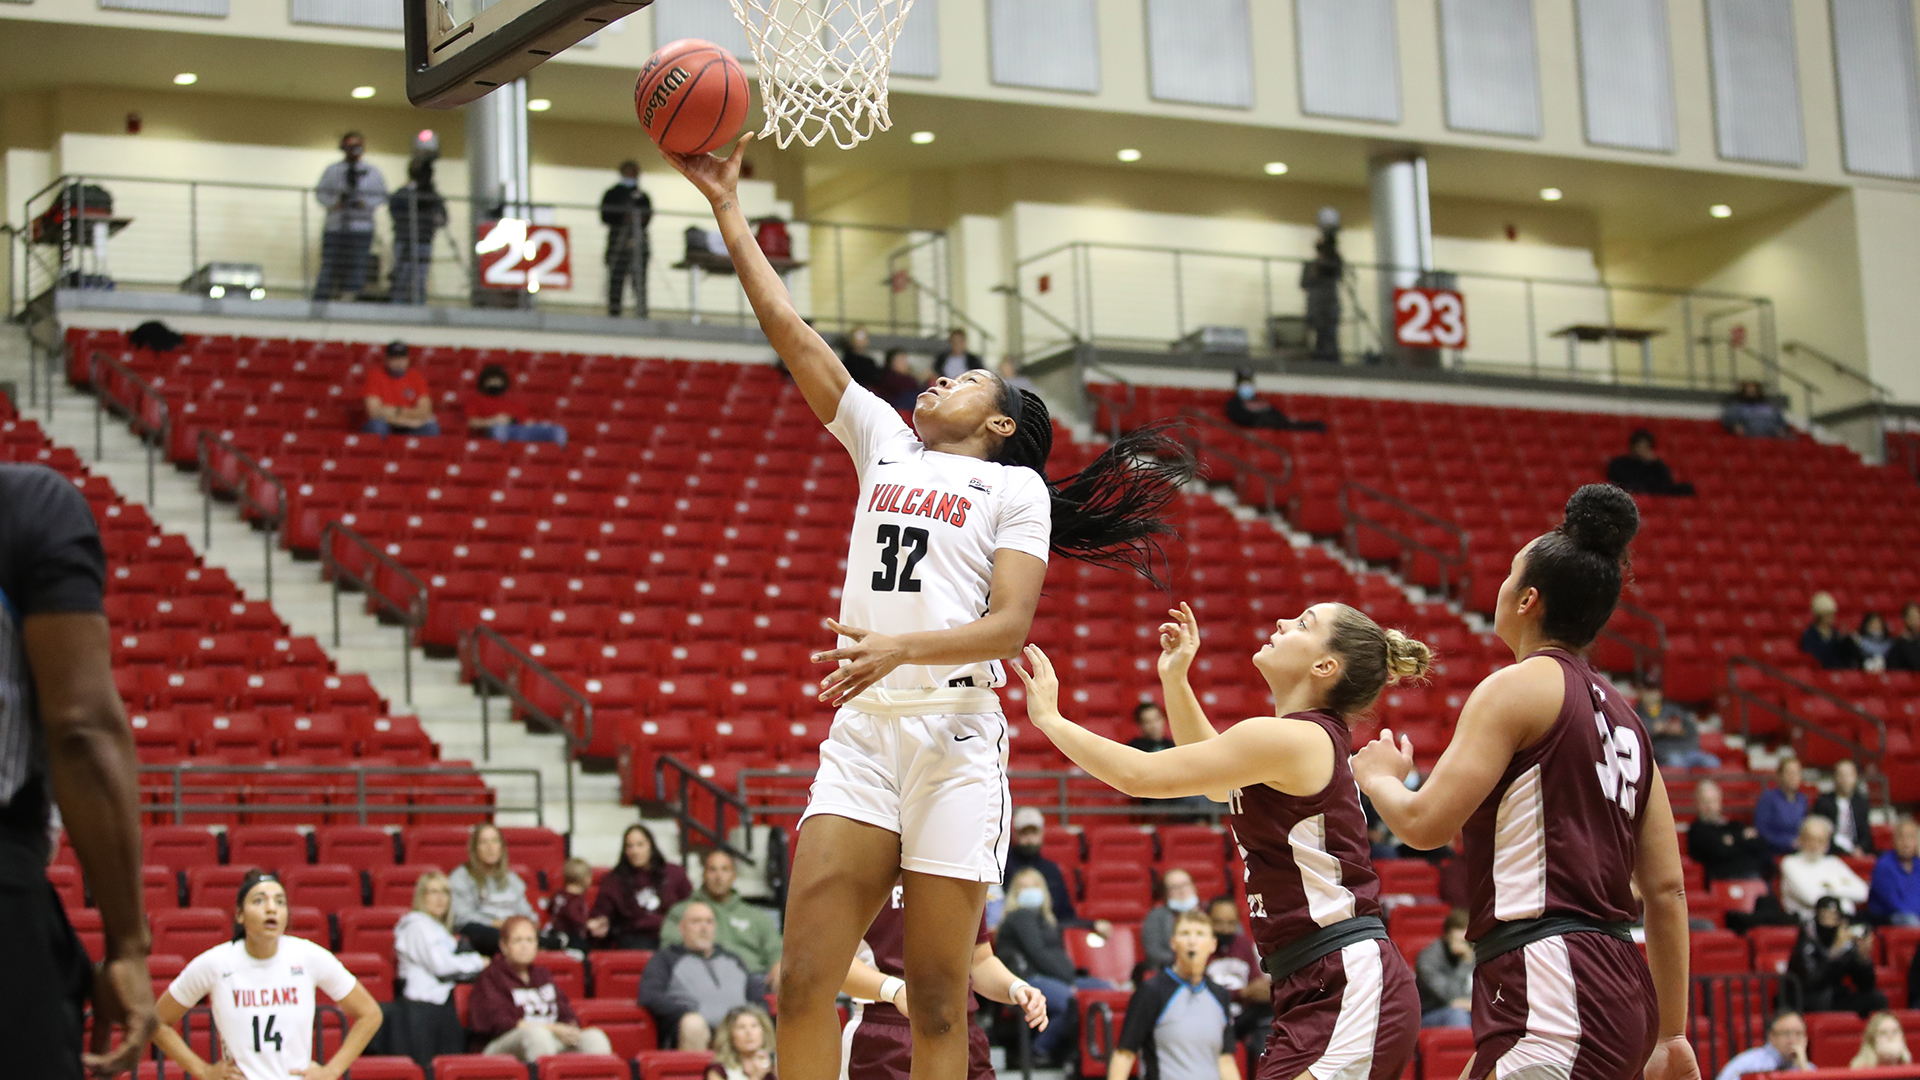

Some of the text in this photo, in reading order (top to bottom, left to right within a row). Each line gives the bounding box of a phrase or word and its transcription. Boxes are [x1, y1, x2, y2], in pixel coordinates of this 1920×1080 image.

[643, 66, 691, 129] Wilson
[485, 223, 568, 286] 22
[1397, 291, 1464, 345] 23
[867, 483, 972, 528] VULCANS
[871, 523, 930, 593] 32
[232, 986, 299, 1008] VULCANS
[252, 1014, 283, 1053] 14
